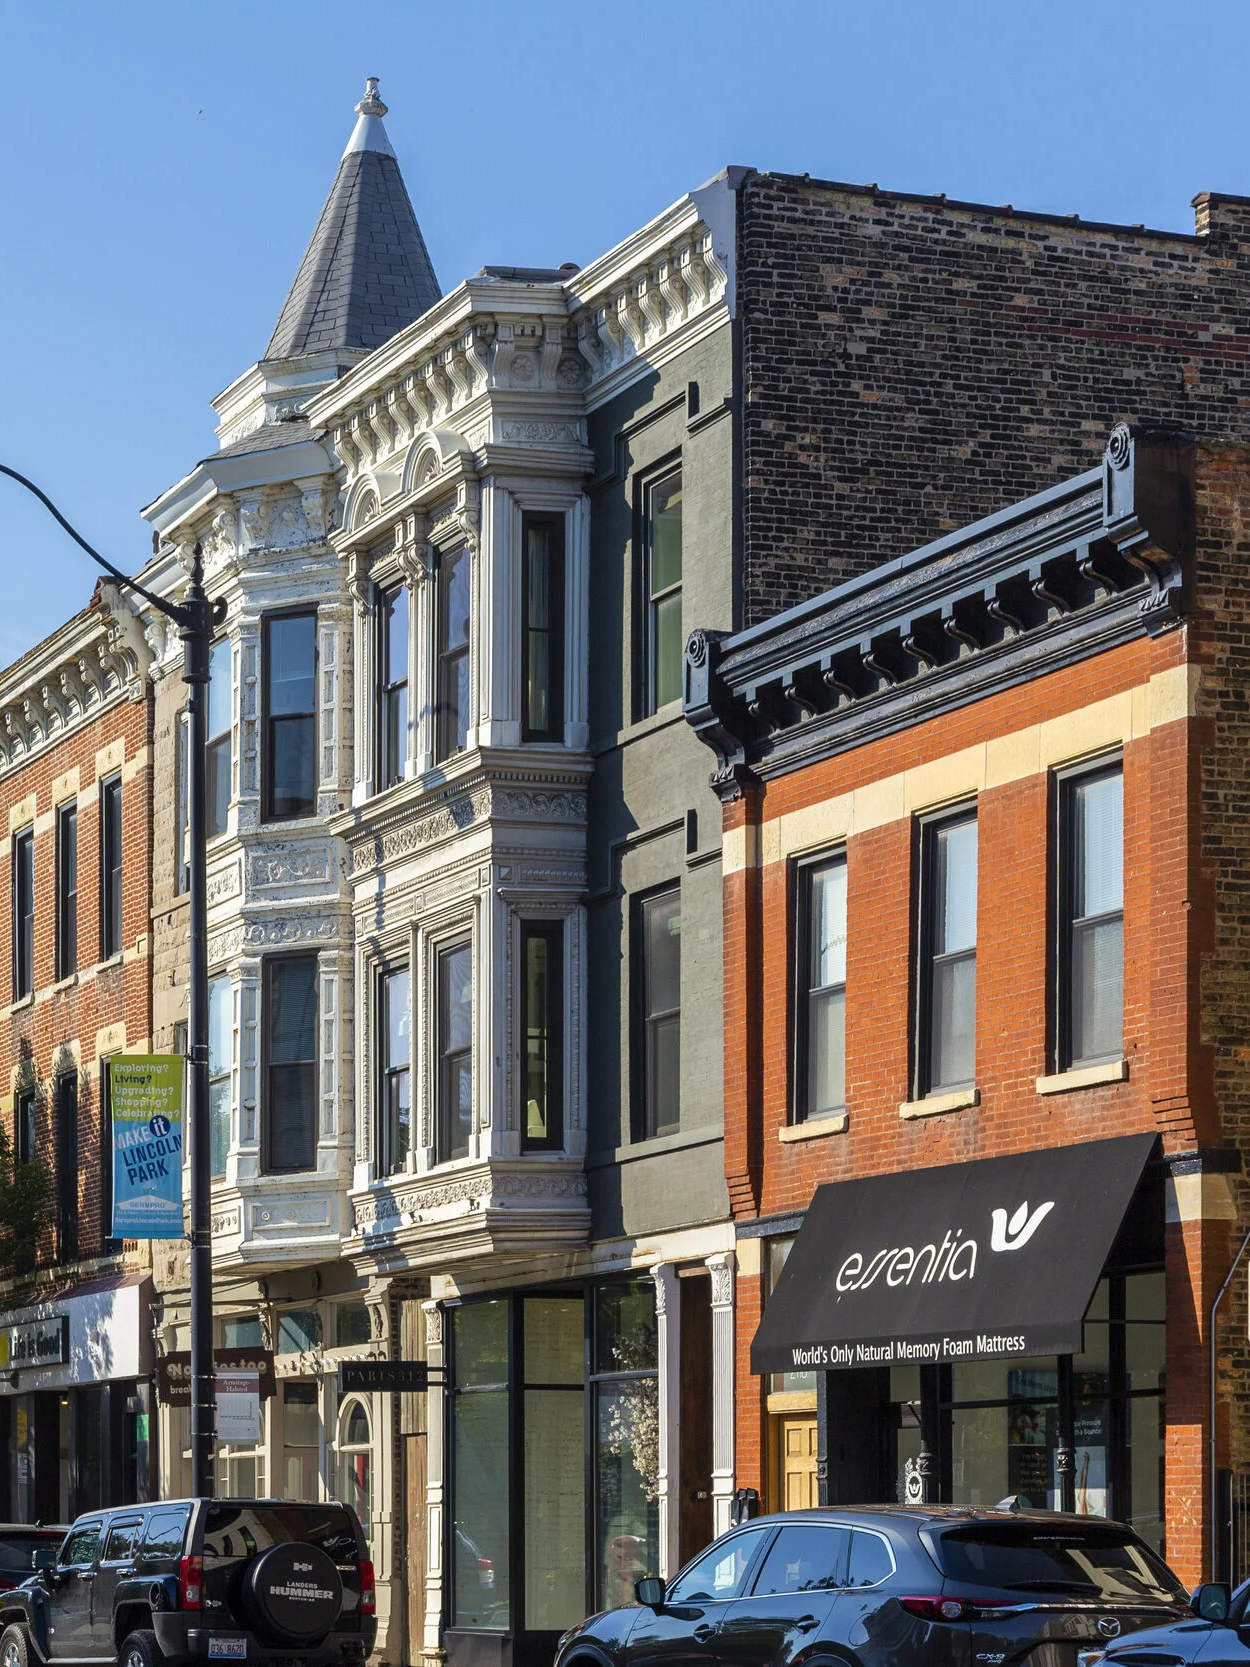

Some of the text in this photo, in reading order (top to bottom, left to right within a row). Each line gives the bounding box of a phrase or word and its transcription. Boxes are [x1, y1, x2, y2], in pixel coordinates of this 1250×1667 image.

[114, 1064, 169, 1074] Exploring?
[115, 1075, 152, 1085] Living?
[115, 1087, 174, 1096] Upgrading?
[115, 1098, 168, 1107] Shopping?
[115, 1109, 180, 1119] Celebrating?
[114, 1118, 167, 1150] MAKE it
[122, 1134, 182, 1168] LINCOLN
[127, 1158, 169, 1186] PARK
[836, 1228, 978, 1292] essentia
[9, 1327, 60, 1361] Life is Good
[792, 1334, 1025, 1365] World's Only Natural Memory Foam Mattress
[286, 1581, 318, 1589] LANDERS
[270, 1586, 334, 1599] HUMMER
